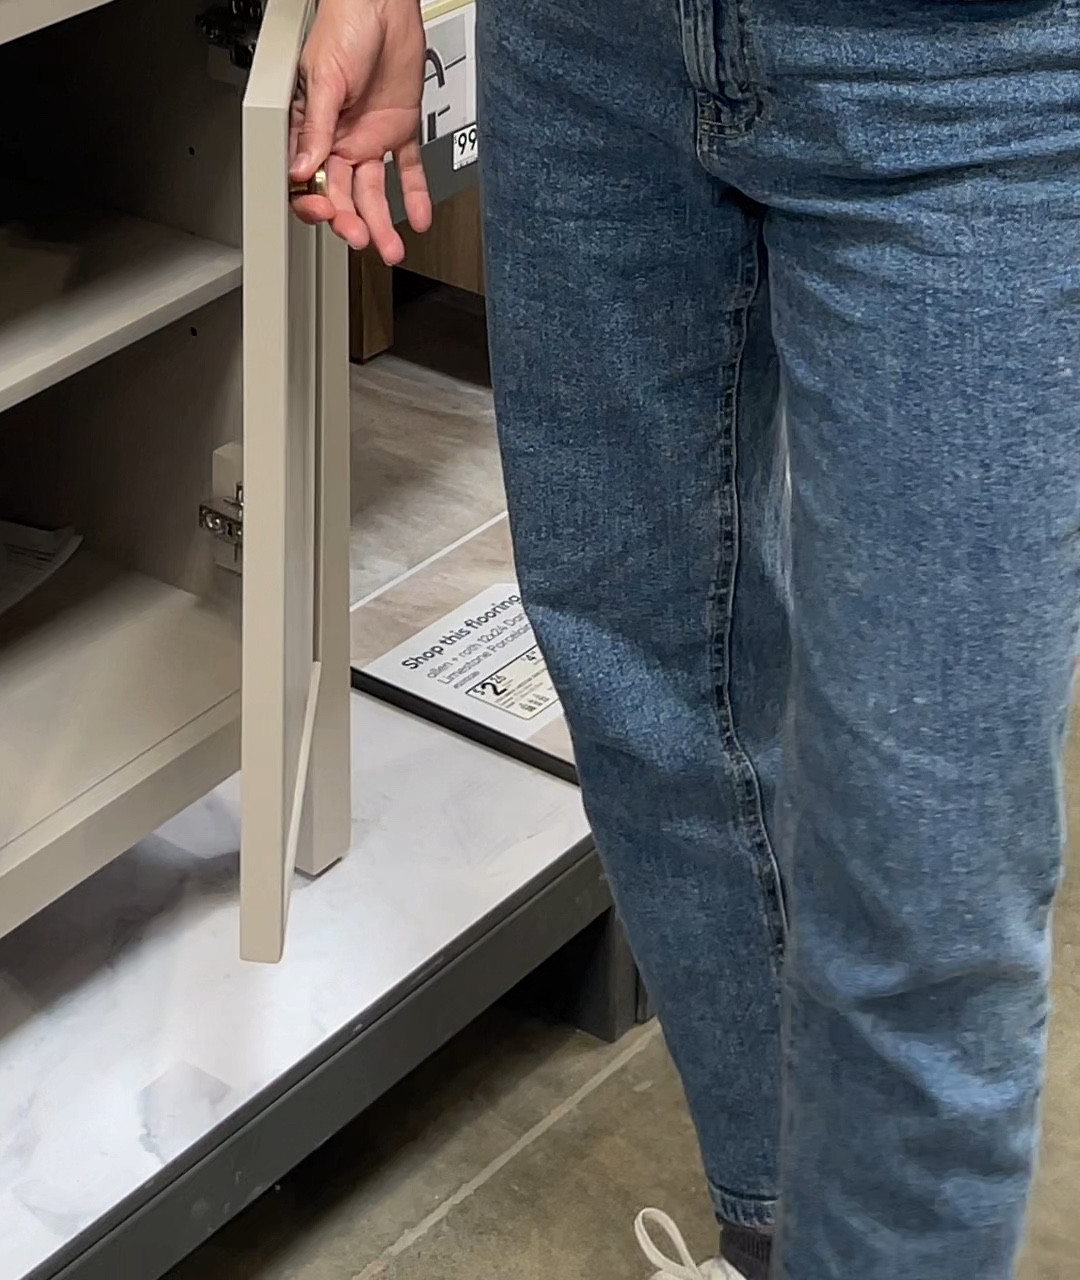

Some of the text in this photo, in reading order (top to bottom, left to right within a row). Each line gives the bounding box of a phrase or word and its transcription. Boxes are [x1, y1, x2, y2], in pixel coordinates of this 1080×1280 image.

[401, 594, 521, 670] Shop this flooring
[426, 659, 451, 679] allen
[459, 643, 481, 661] roth
[438, 651, 492, 685] Limestone
